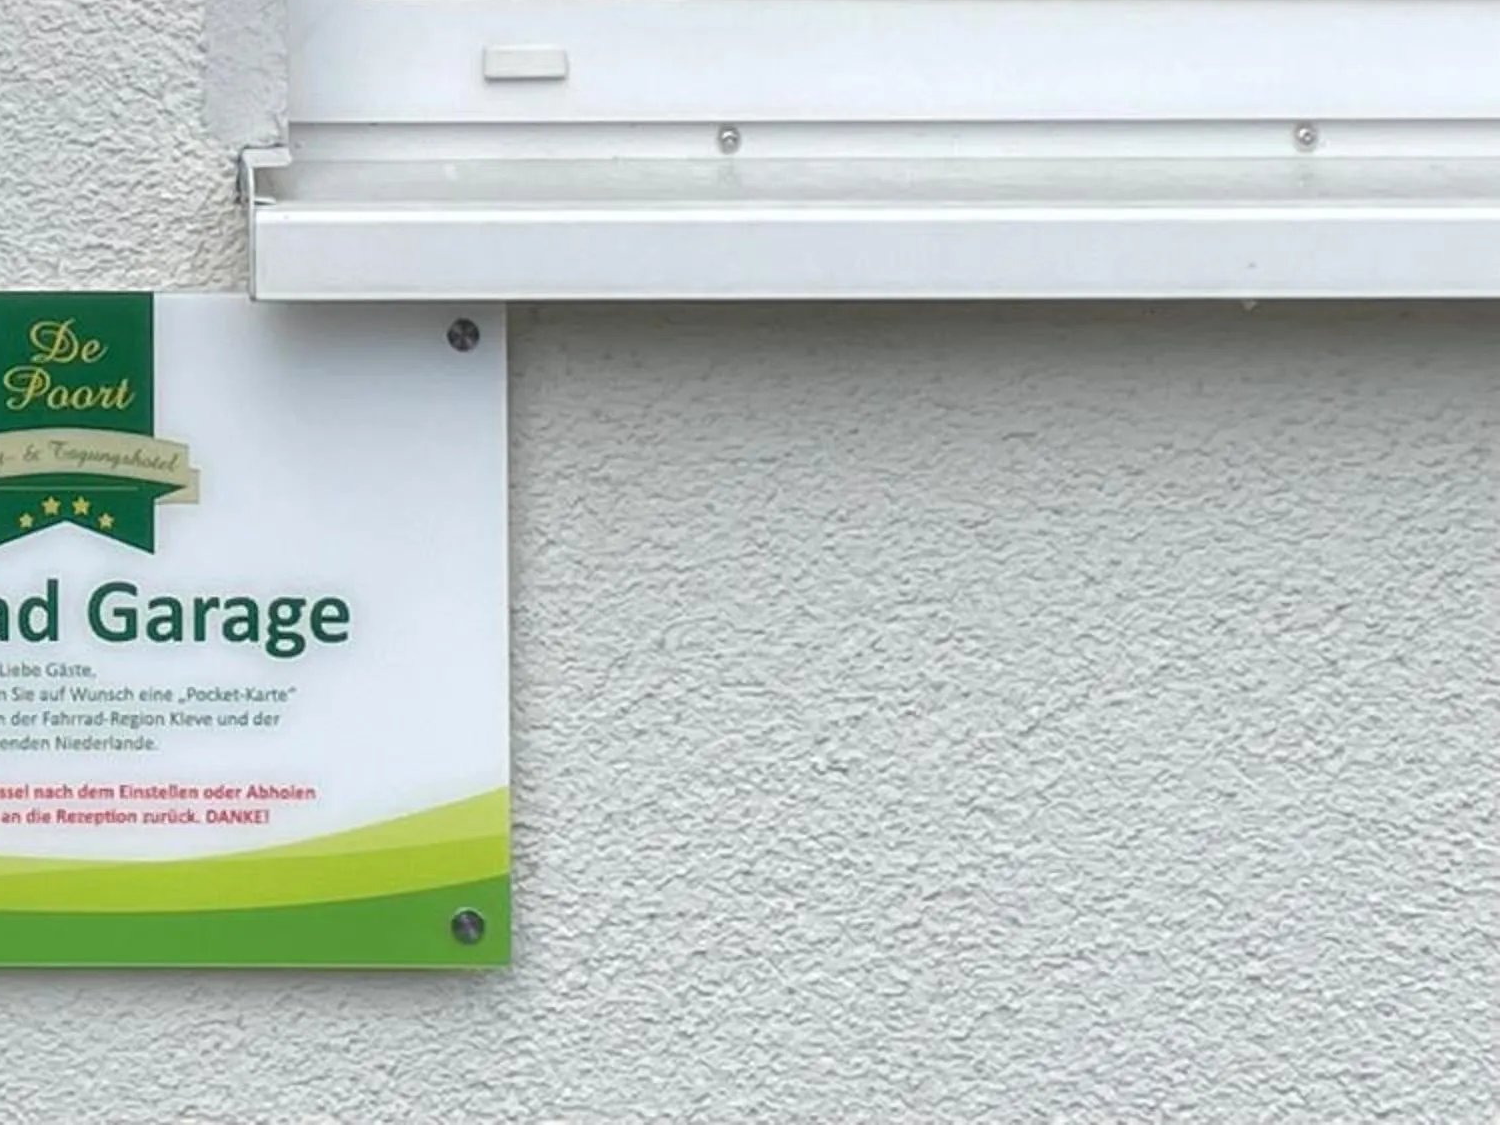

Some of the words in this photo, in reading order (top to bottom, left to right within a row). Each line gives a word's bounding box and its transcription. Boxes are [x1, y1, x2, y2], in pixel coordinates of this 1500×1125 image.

[29, 319, 108, 363] De
[3, 365, 135, 410] Poort
[23, 444, 40, 462] &
[87, 581, 352, 659] Garage
[45, 663, 97, 679] Gäste,
[11, 687, 34, 702] Sie
[39, 687, 66, 702] auf
[70, 686, 134, 702] Wunsch
[139, 687, 173, 702] eine
[11, 712, 36, 726] der
[42, 711, 165, 729] Fahrrad-Region
[170, 712, 212, 726] Kleve
[217, 712, 249, 726] und
[253, 712, 280, 726] der
[55, 736, 159, 751] Niederlande.
[34, 784, 73, 799] nach
[77, 784, 114, 799] dem
[119, 784, 198, 799] Einstellen
[203, 784, 241, 799] oder
[246, 784, 316, 799] Abholen
[1, 812, 20, 824] an
[26, 808, 50, 824] die
[57, 809, 137, 826] Rezeption
[143, 808, 199, 824] zurück.
[206, 809, 269, 824] DANKE!
